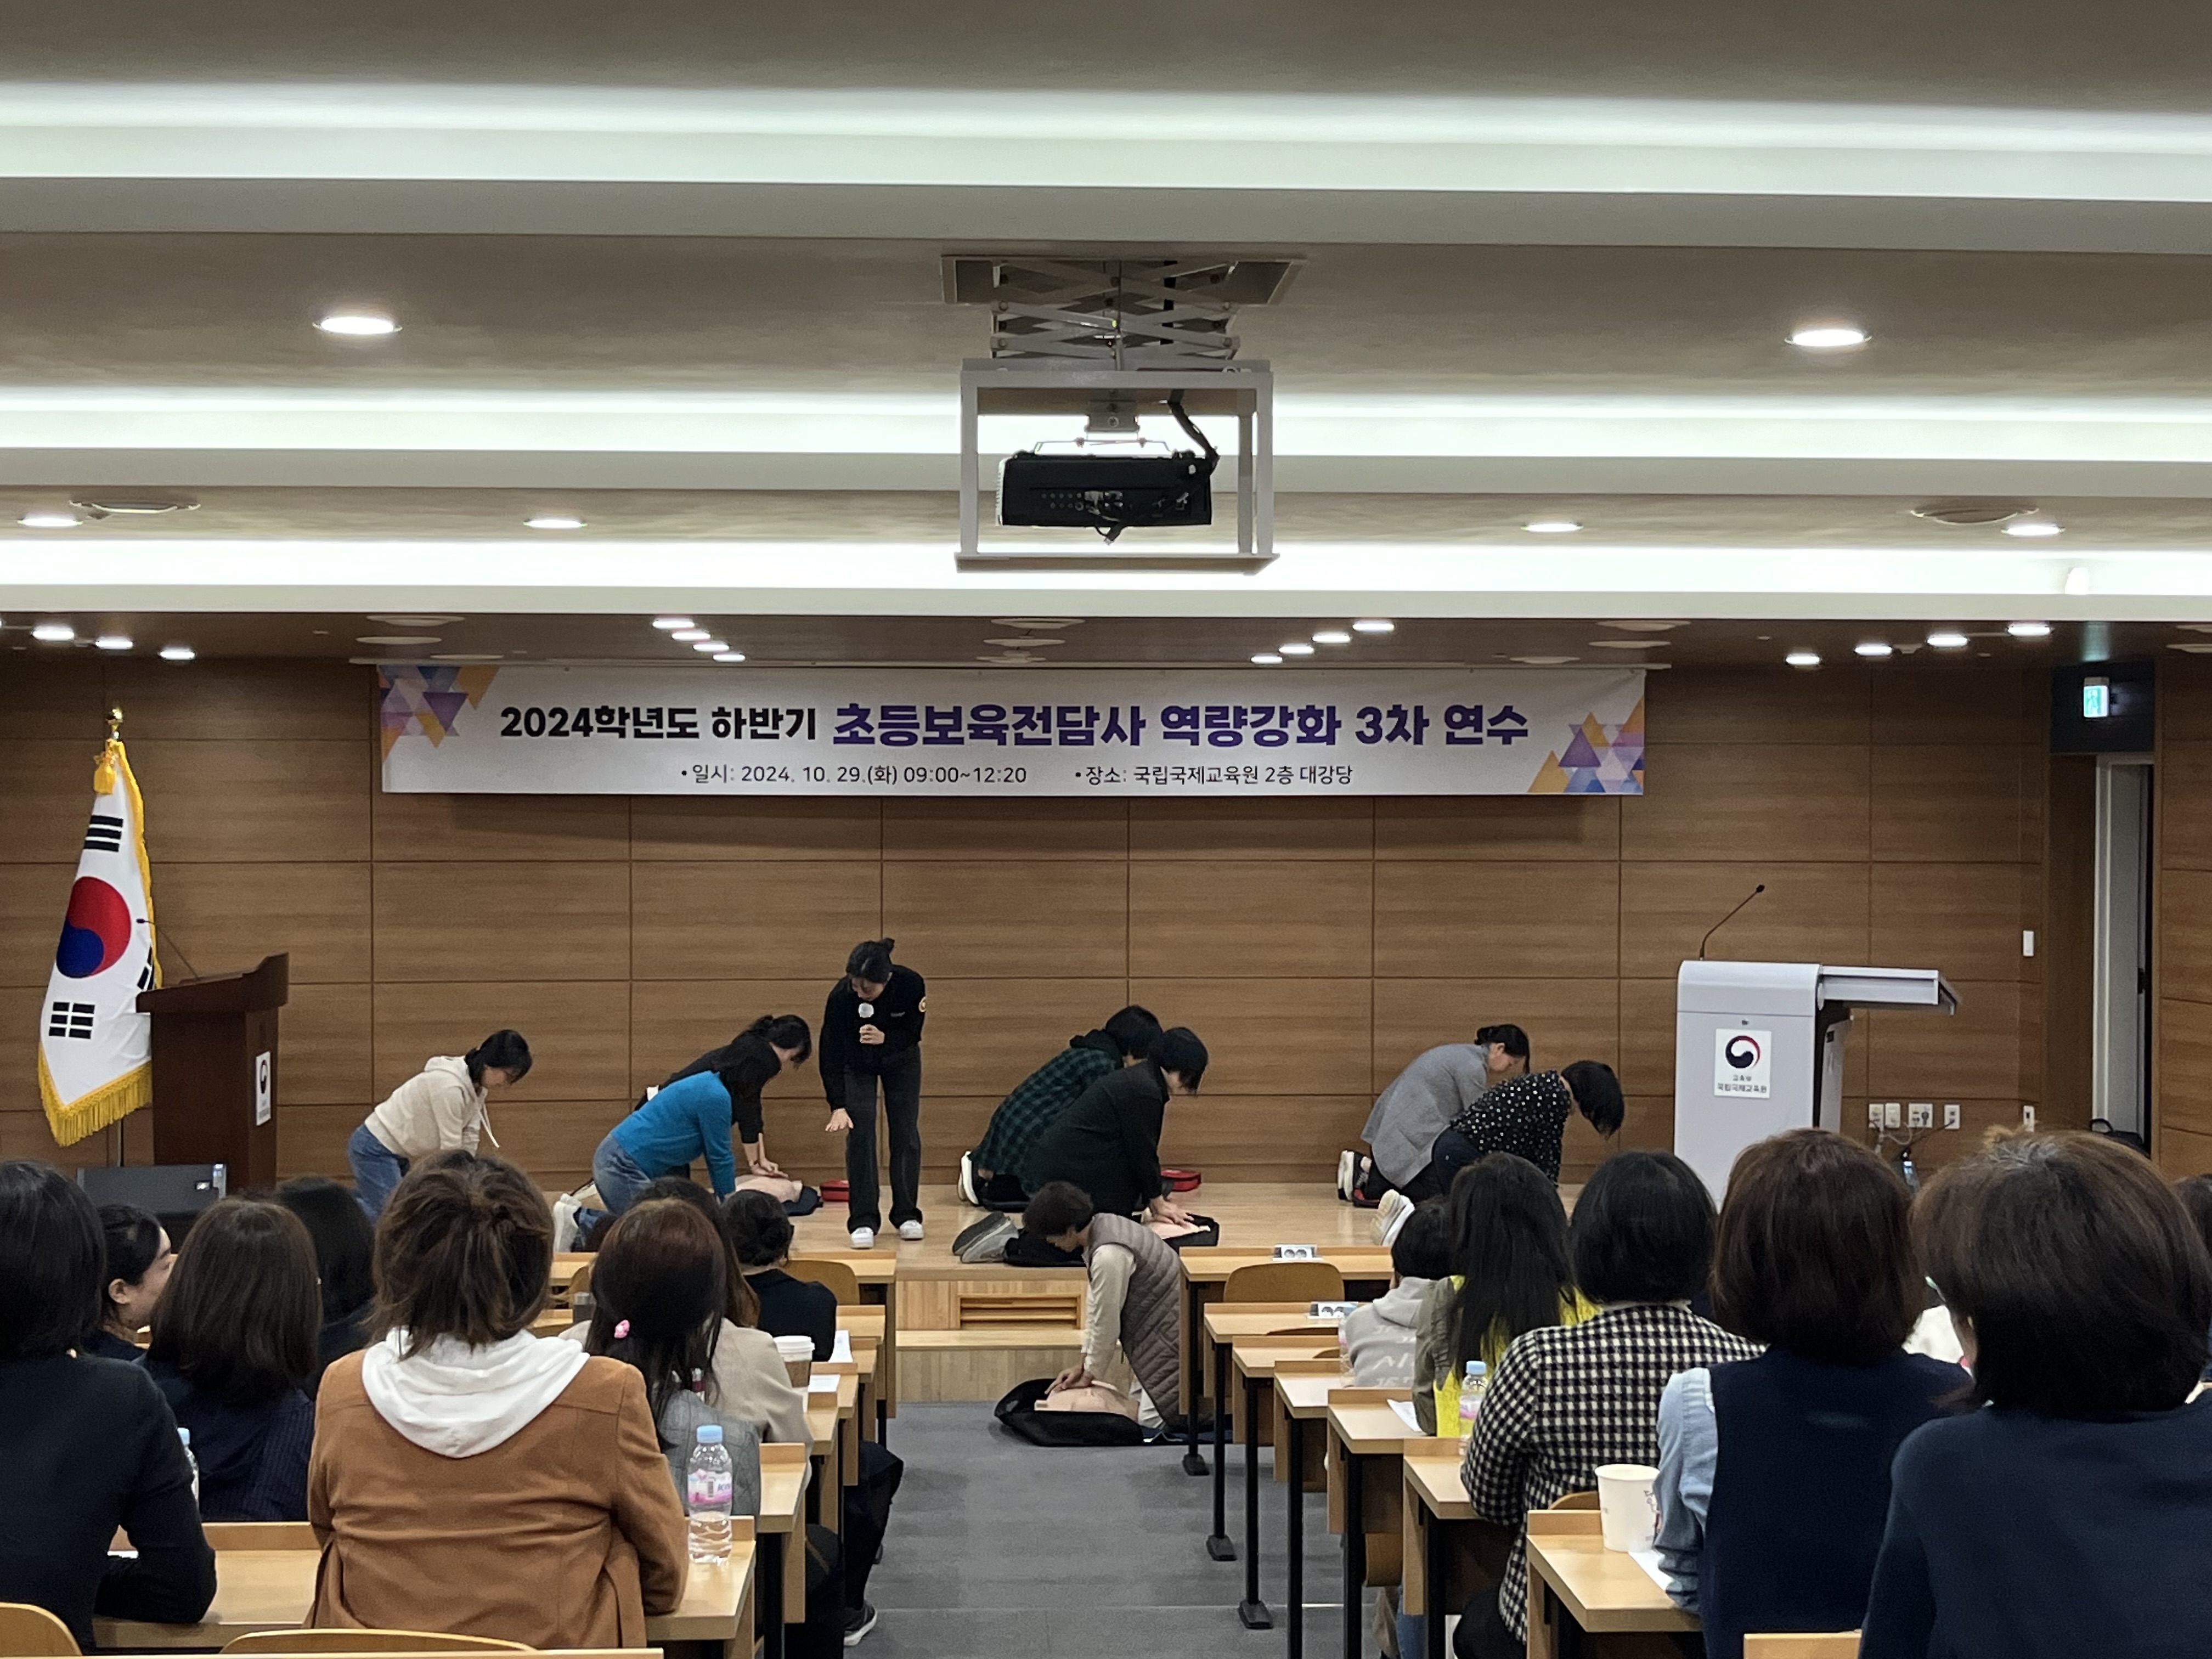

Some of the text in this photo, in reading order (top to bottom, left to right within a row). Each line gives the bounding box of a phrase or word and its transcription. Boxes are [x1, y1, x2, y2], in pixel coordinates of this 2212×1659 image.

[500, 703, 1529, 748] 2024학년도 하반기 초등보육전담사 역량강화 3차 연수
[692, 764, 735, 784] 일시:
[741, 766, 795, 783] 2024.
[802, 766, 831, 783] 10.
[903, 766, 1027, 783] 09:00~12:20
[1085, 764, 1353, 786] 장소: 국립국제교육원 2층 대강당
